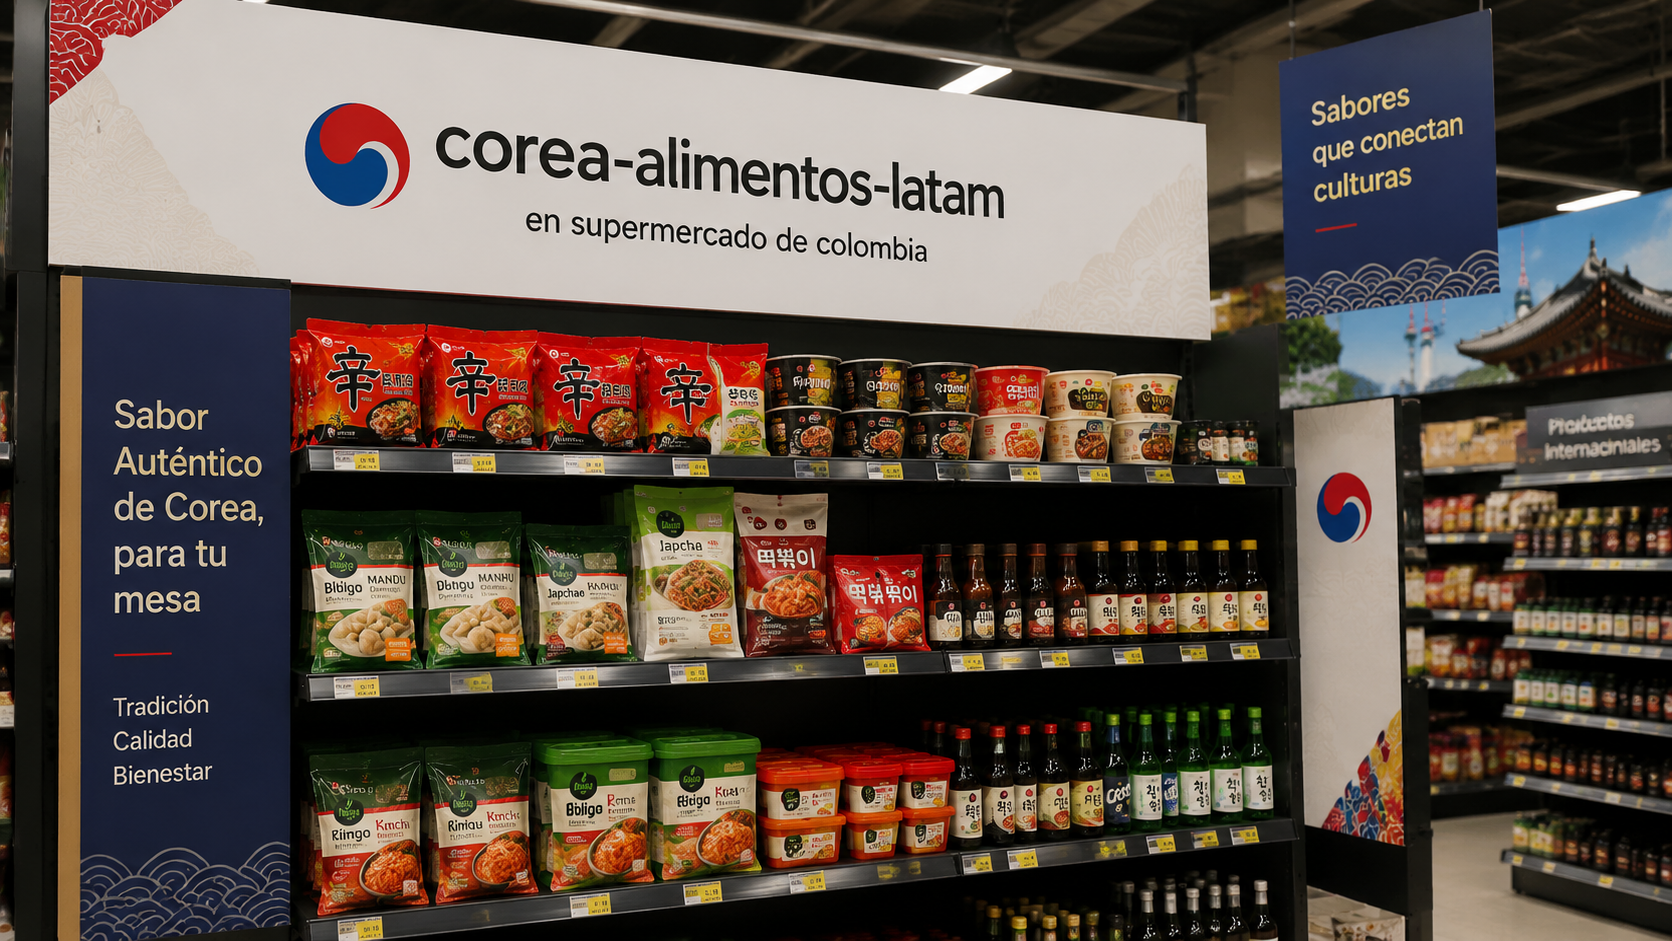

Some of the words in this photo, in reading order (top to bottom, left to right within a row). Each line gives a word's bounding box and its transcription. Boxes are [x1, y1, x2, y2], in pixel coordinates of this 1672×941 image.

[1311, 87, 1410, 127] Sabores
[1312, 140, 1356, 168] que
[1360, 115, 1464, 155] conectan
[436, 125, 1006, 219] corea-alimentos-latam
[1313, 167, 1412, 203] culturas
[525, 213, 560, 235] en
[571, 216, 768, 251] supermercado
[776, 227, 808, 254] de
[816, 232, 928, 263] colombia
[325, 345, 381, 413] 辛
[445, 351, 497, 416] 辛
[553, 358, 600, 421] 辛
[114, 398, 209, 431] Sabor
[113, 446, 263, 478] Auténtico
[113, 491, 155, 522] de
[165, 490, 264, 527] Corea,
[113, 545, 186, 576] para
[195, 539, 227, 568] tu
[113, 589, 201, 615] mesa
[112, 692, 210, 718] Tradición
[113, 726, 193, 752] Calidad
[113, 762, 214, 787] Bienestar
